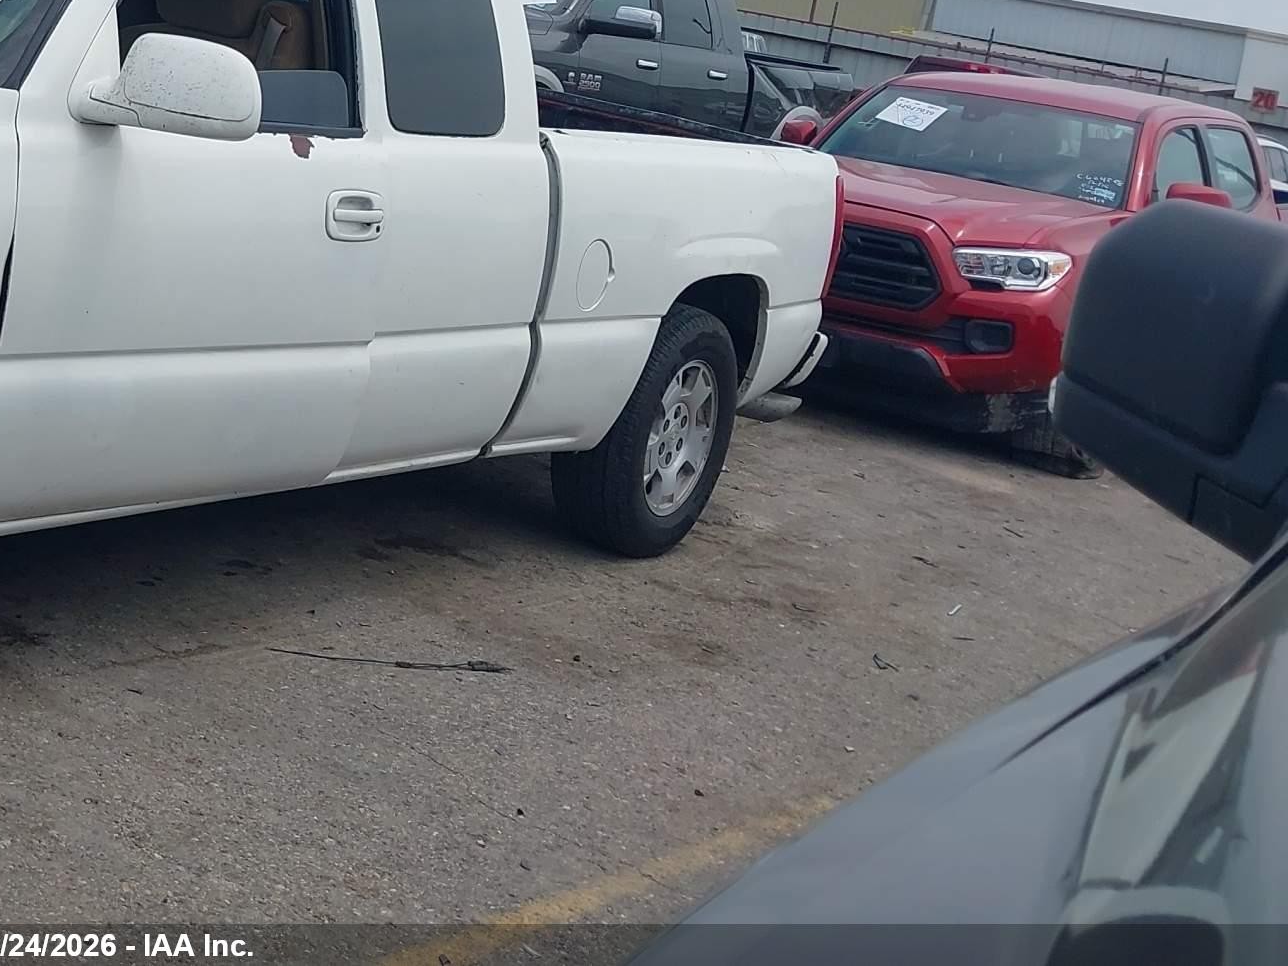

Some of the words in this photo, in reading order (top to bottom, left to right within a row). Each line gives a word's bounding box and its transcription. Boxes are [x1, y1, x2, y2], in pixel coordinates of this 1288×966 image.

[580, 72, 602, 82] RAM
[578, 80, 601, 90] 2500
[1255, 91, 1276, 110] 20
